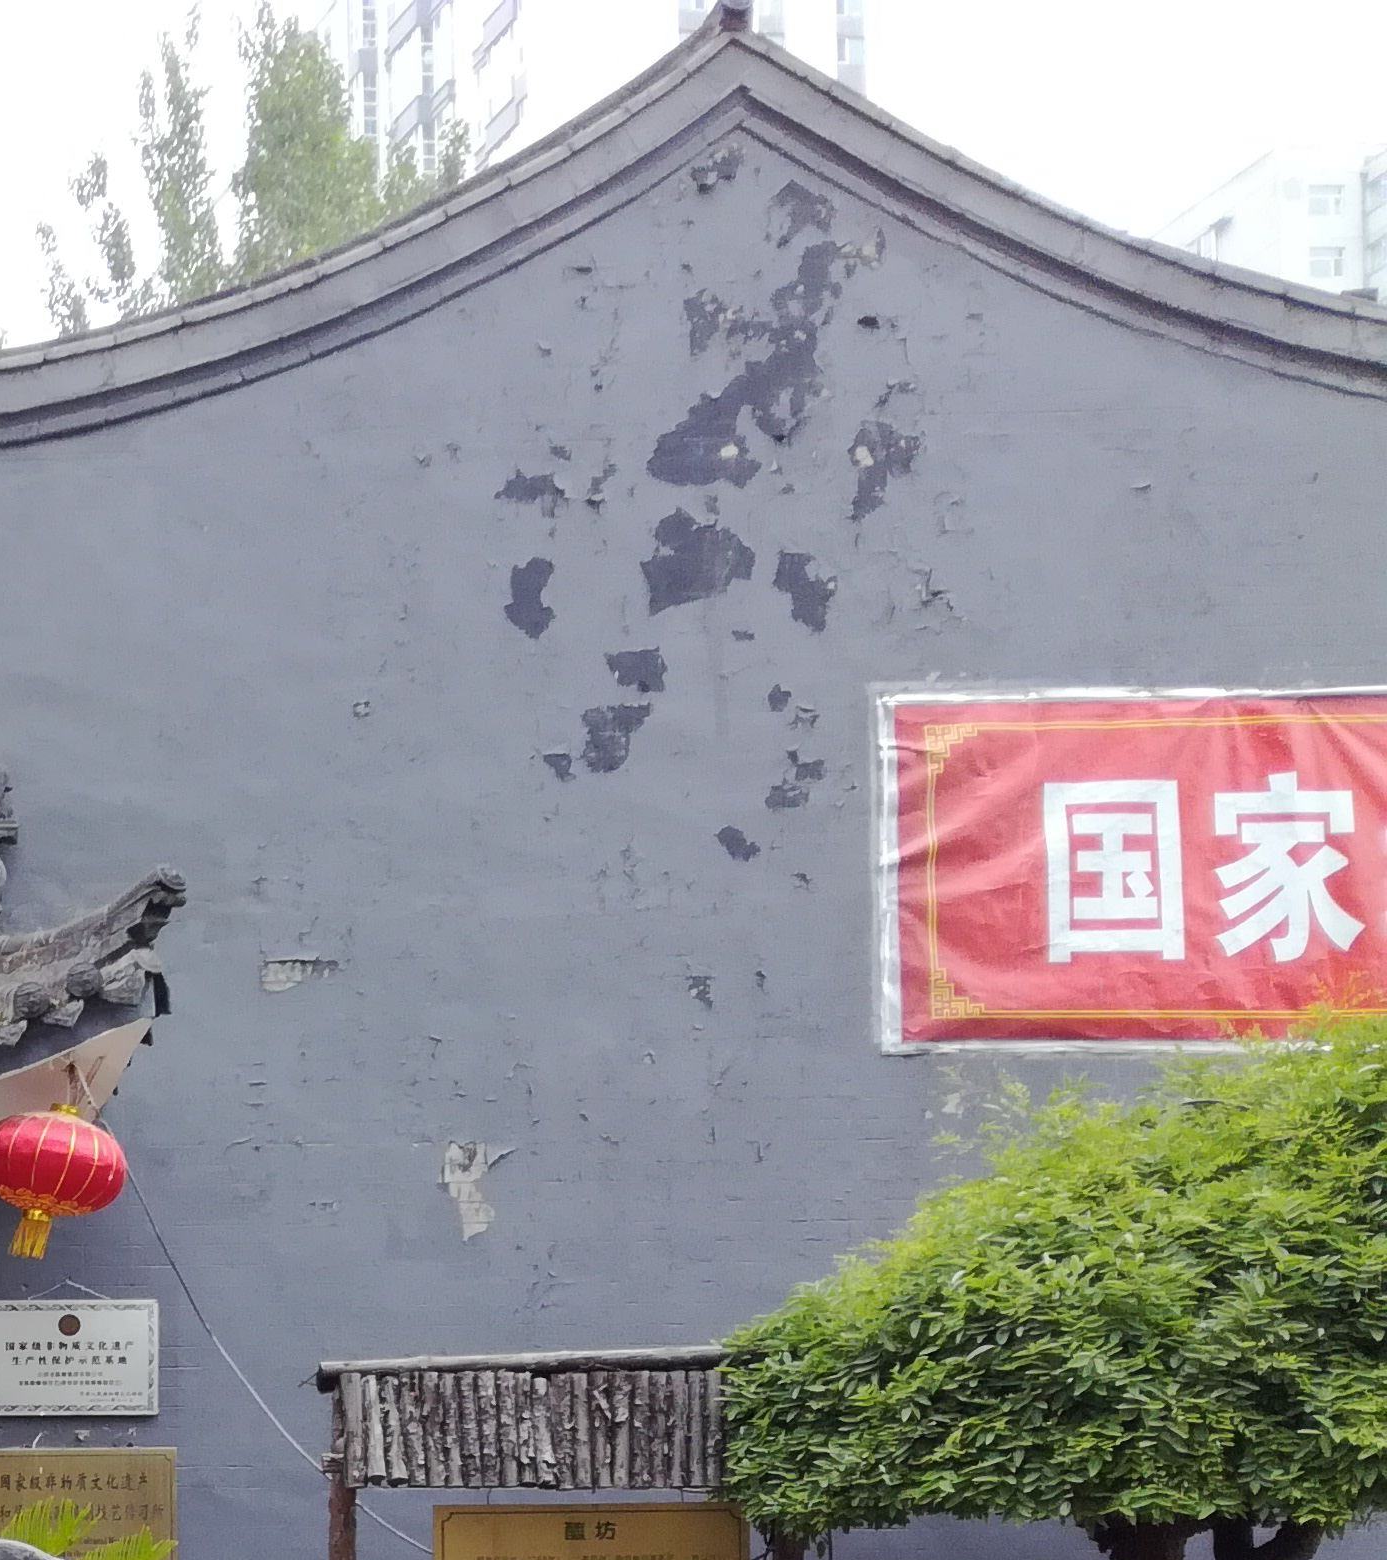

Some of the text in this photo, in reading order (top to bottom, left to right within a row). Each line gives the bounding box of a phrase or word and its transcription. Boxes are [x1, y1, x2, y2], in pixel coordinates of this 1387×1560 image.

[1042, 770, 1366, 964] 国家
[10, 1355, 129, 1366] 生产性保护示范基地
